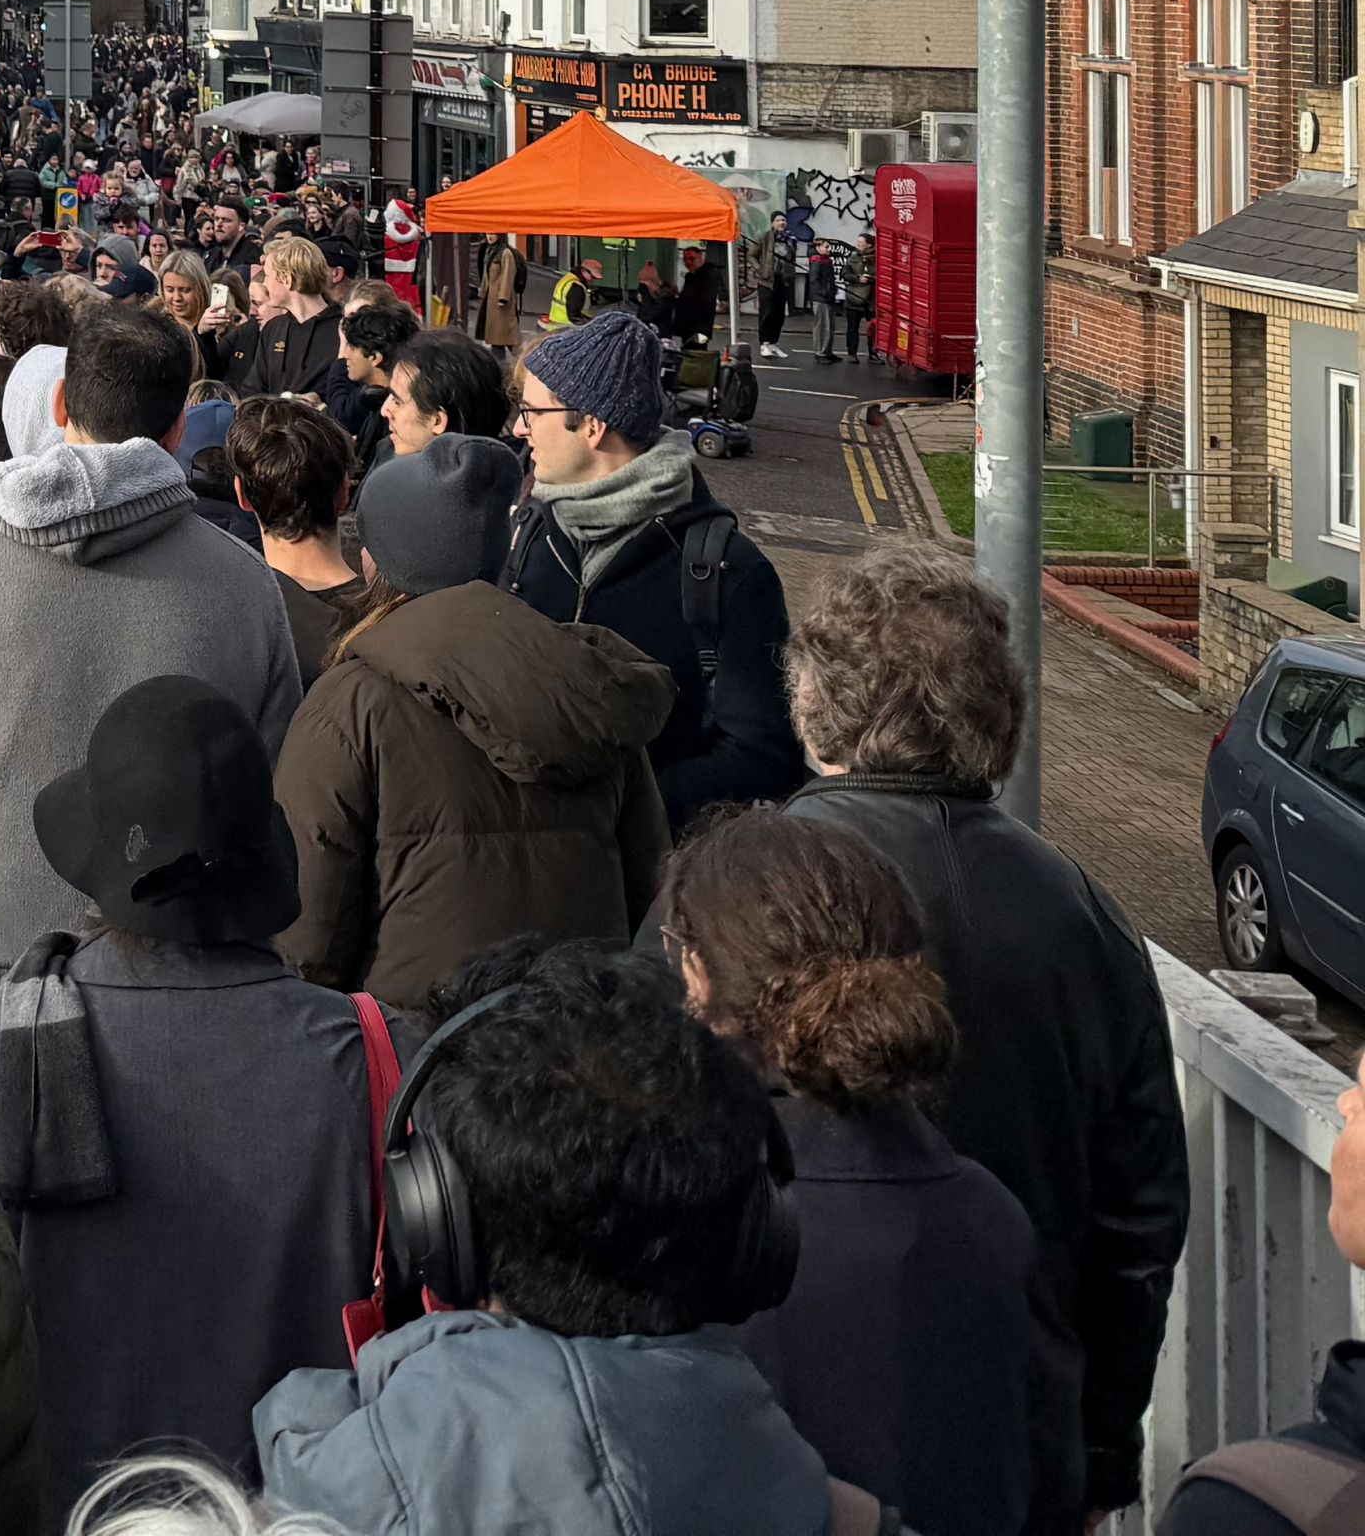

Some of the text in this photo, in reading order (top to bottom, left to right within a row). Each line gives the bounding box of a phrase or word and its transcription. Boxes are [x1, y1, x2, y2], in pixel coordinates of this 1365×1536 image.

[555, 58, 579, 86] PHONE
[580, 61, 596, 87] HUB
[618, 82, 686, 109] PHONE
[701, 112, 725, 121] MILL
[725, 113, 742, 121] RD
